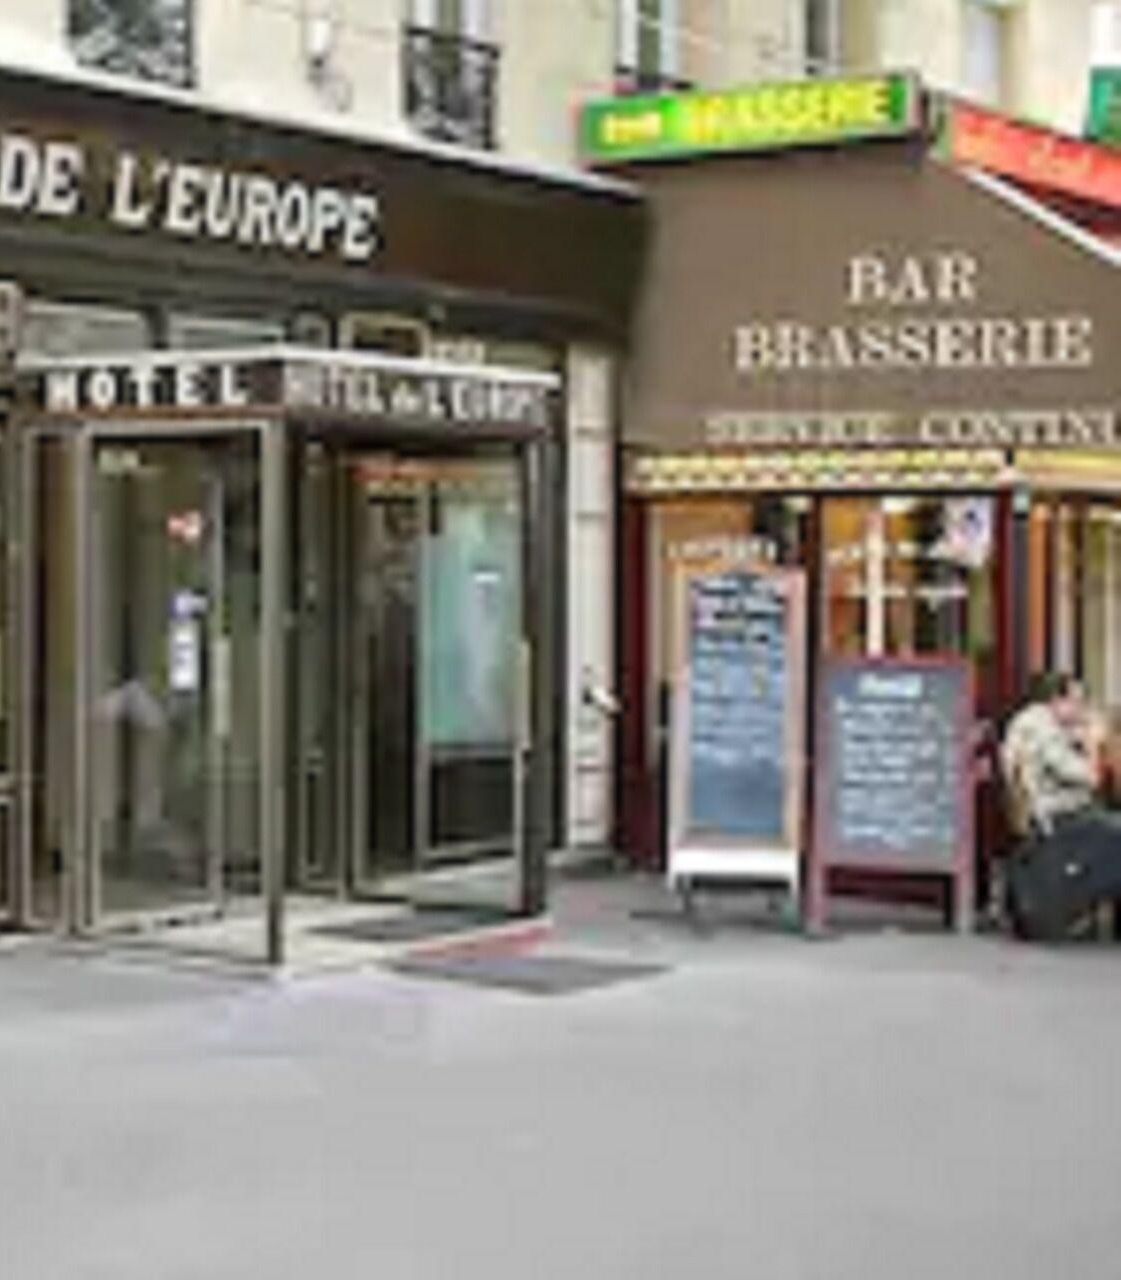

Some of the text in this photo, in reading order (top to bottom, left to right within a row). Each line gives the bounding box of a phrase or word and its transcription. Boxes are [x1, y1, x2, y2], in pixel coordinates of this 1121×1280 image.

[115, 151, 379, 261] L'EUROPE
[846, 252, 980, 306] BAR
[732, 316, 1094, 372] BRASSERIE
[44, 362, 251, 410] HOTEL
